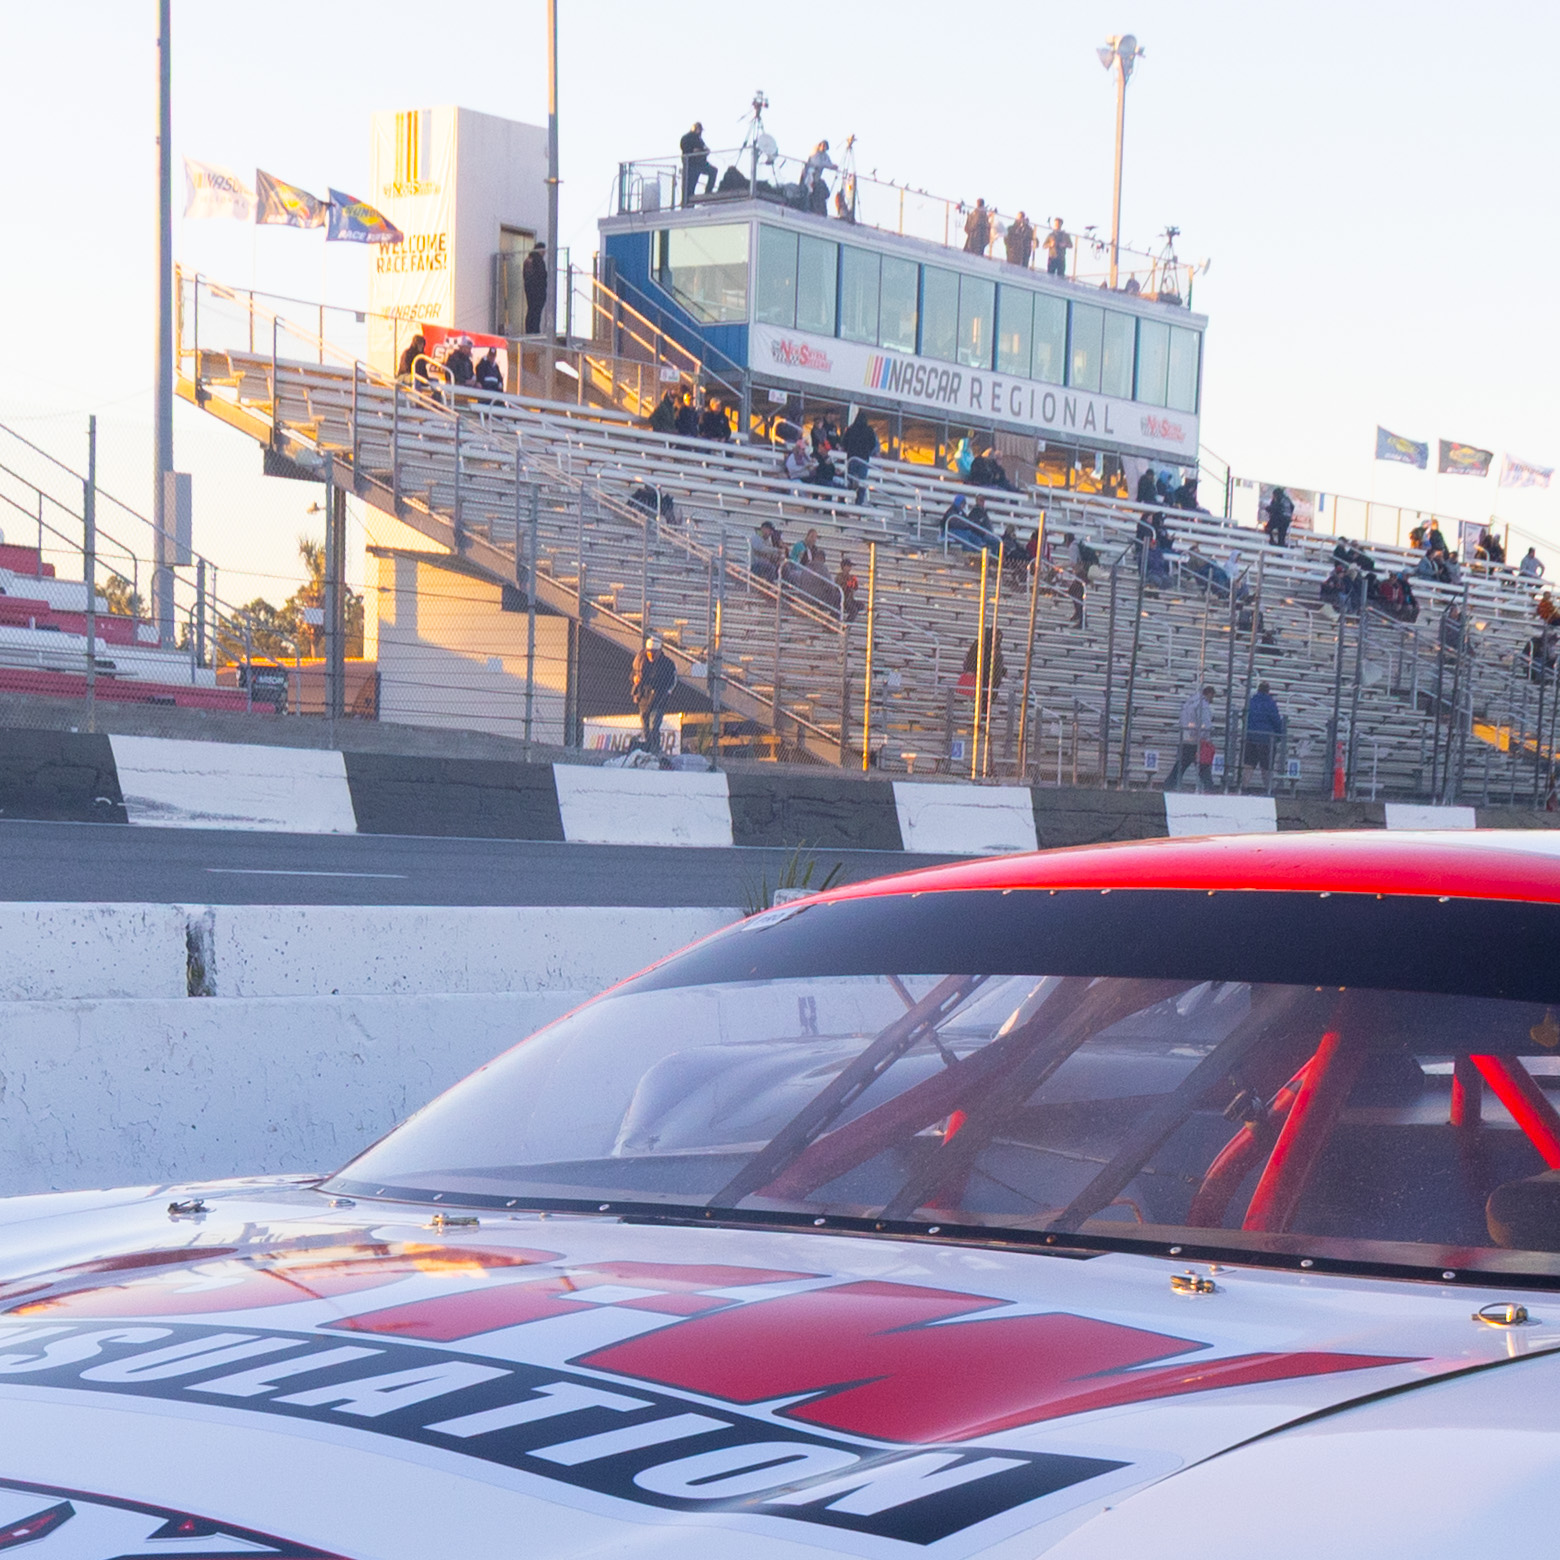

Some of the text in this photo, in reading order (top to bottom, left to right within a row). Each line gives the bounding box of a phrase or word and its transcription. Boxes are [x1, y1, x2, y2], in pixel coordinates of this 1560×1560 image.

[376, 253, 448, 274] RACE FANS!
[889, 360, 961, 404] NASCAR
[970, 376, 1115, 435] REGIONAL
